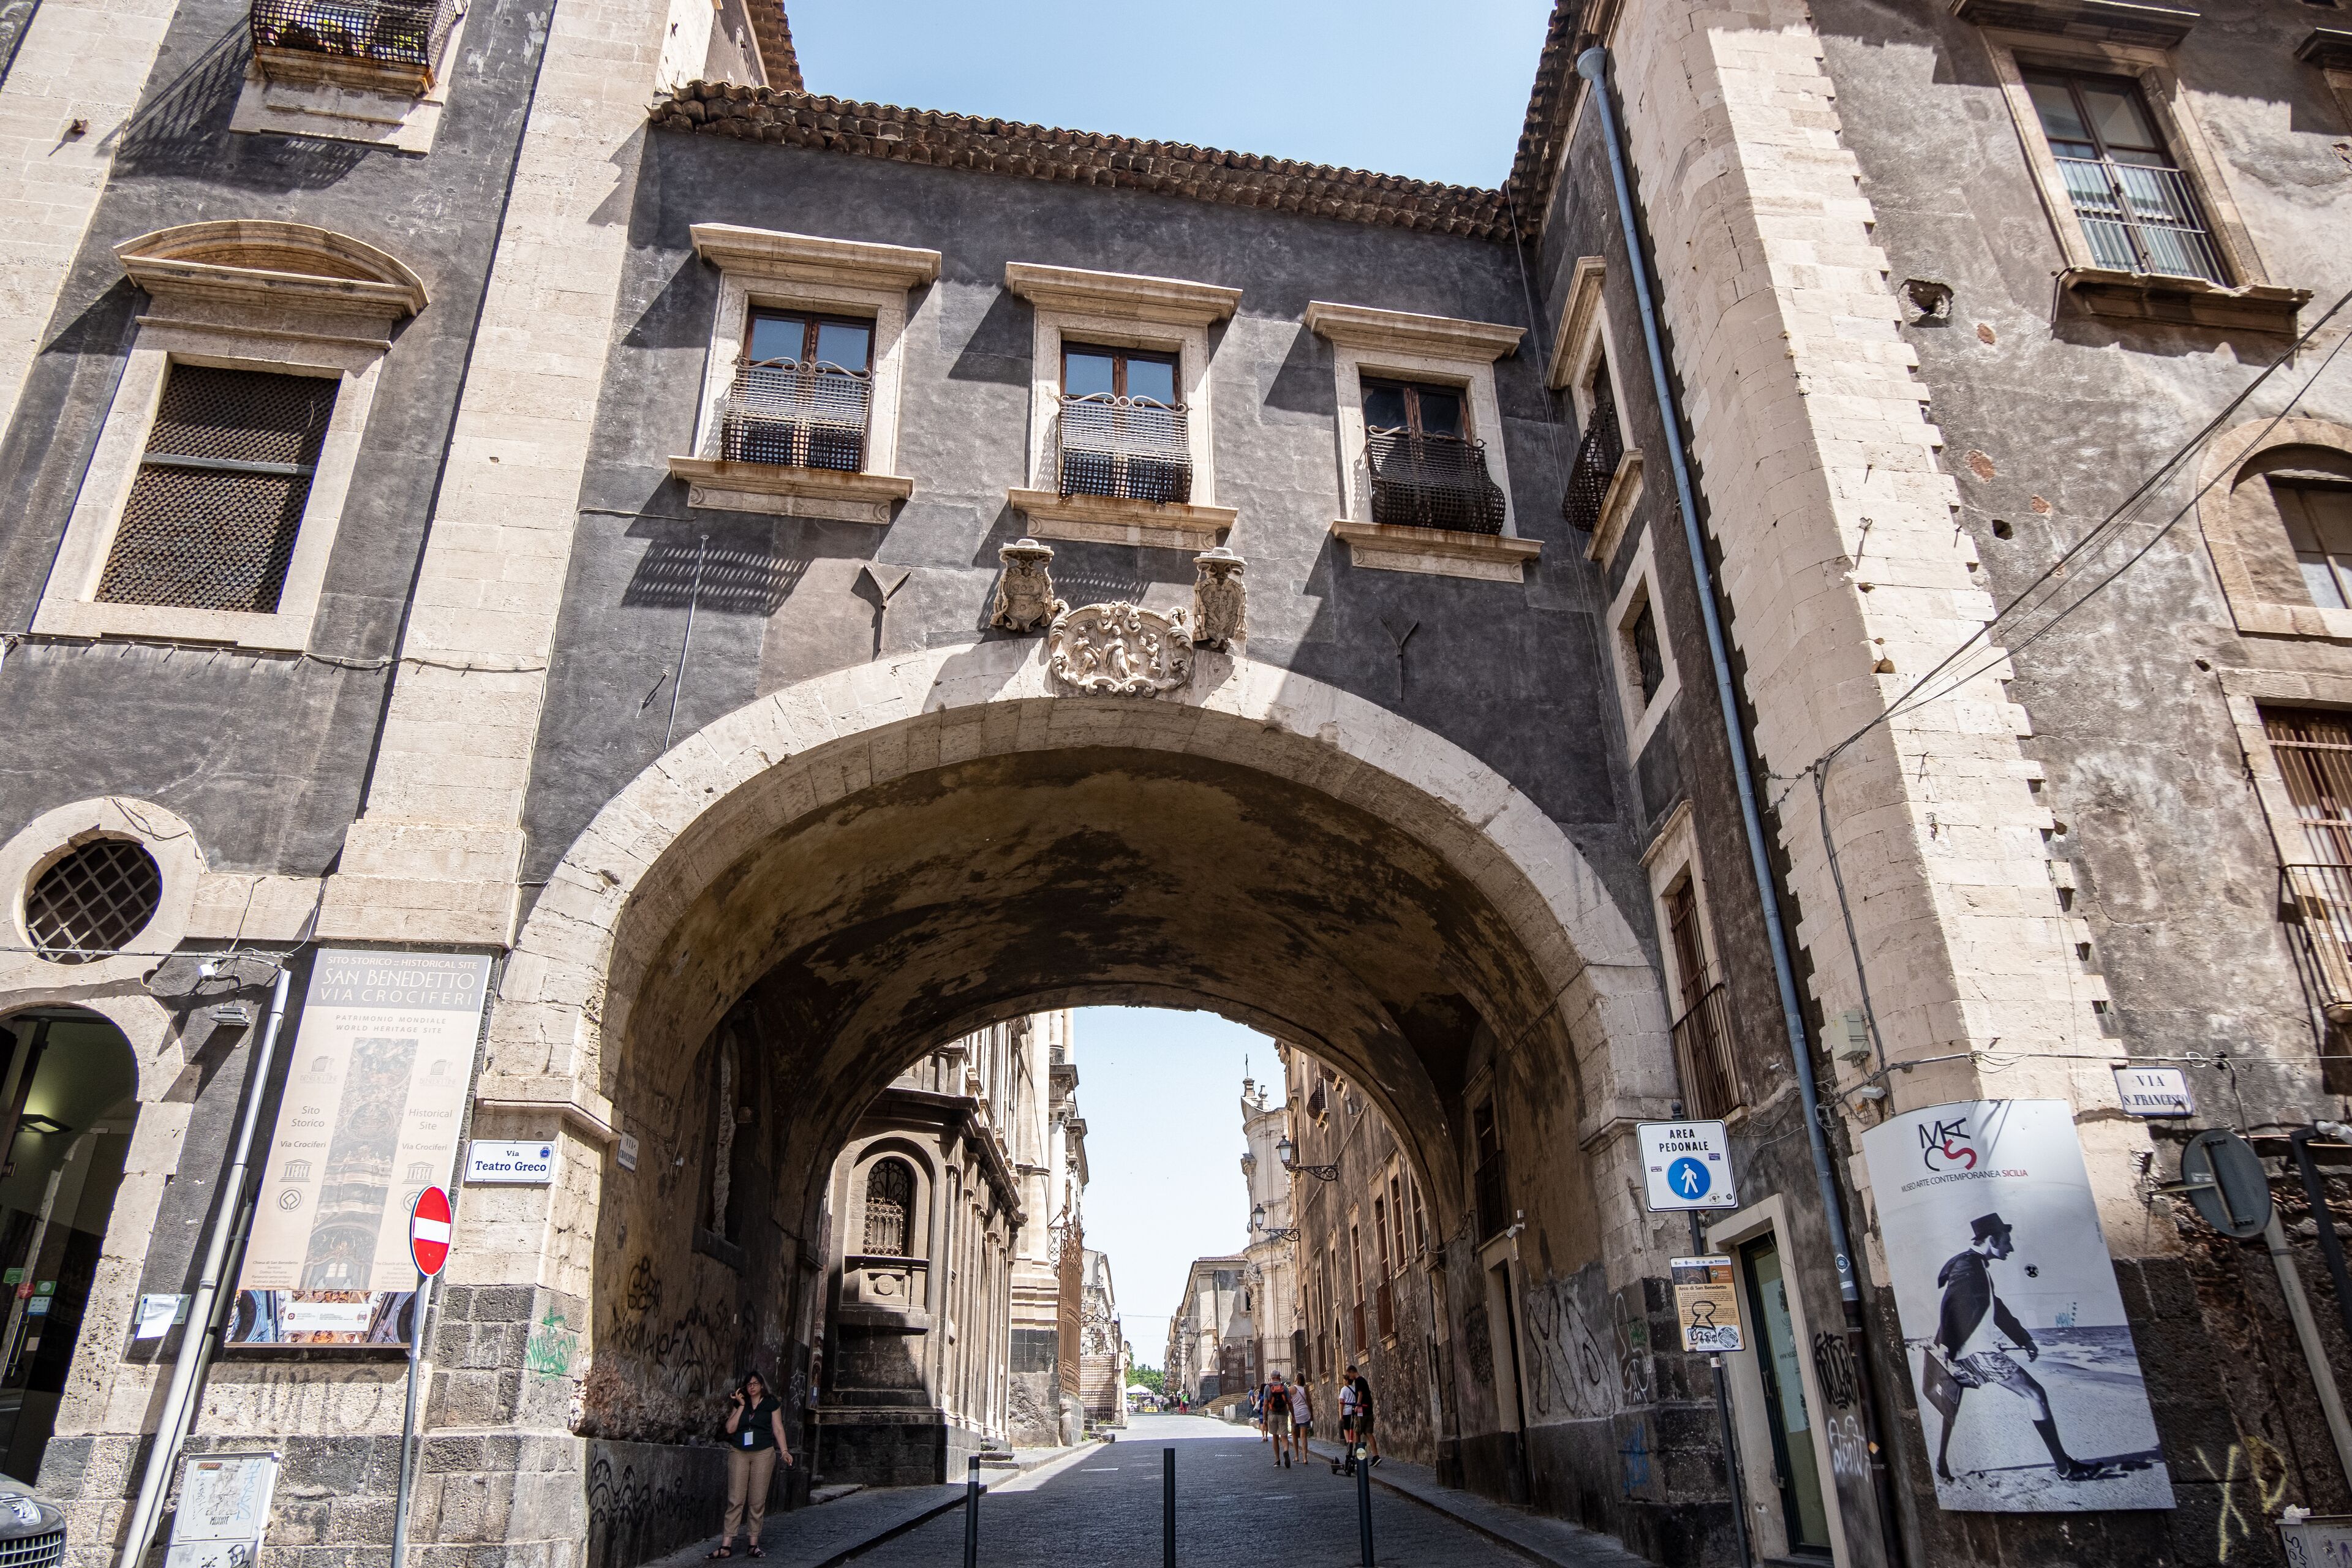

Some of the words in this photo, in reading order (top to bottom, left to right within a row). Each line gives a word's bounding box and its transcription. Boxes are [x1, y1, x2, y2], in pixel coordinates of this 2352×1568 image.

[350, 957, 392, 966] STORICO
[401, 959, 456, 968] HISTORICAL
[458, 961, 478, 970] SITE
[322, 968, 360, 986] SAN
[367, 969, 475, 990] BENEDETTO
[320, 988, 353, 1001] VIA
[361, 989, 472, 1005] CROCIFERI
[2135, 1075, 2165, 1086] VIA
[301, 1106, 320, 1114] Sito
[409, 1109, 453, 1118] Historical
[292, 1118, 325, 1128] Storico
[419, 1121, 437, 1130] Site
[1670, 1129, 1695, 1139] AREA
[1659, 1141, 1709, 1152] PEDONALE
[475, 1161, 511, 1171] Teatro
[514, 1161, 546, 1172] Greco
[1901, 1182, 1916, 1193] MUSEO
[1916, 1178, 1930, 1189] ARTE
[1931, 1170, 2001, 1185] CONTEMPORANEA
